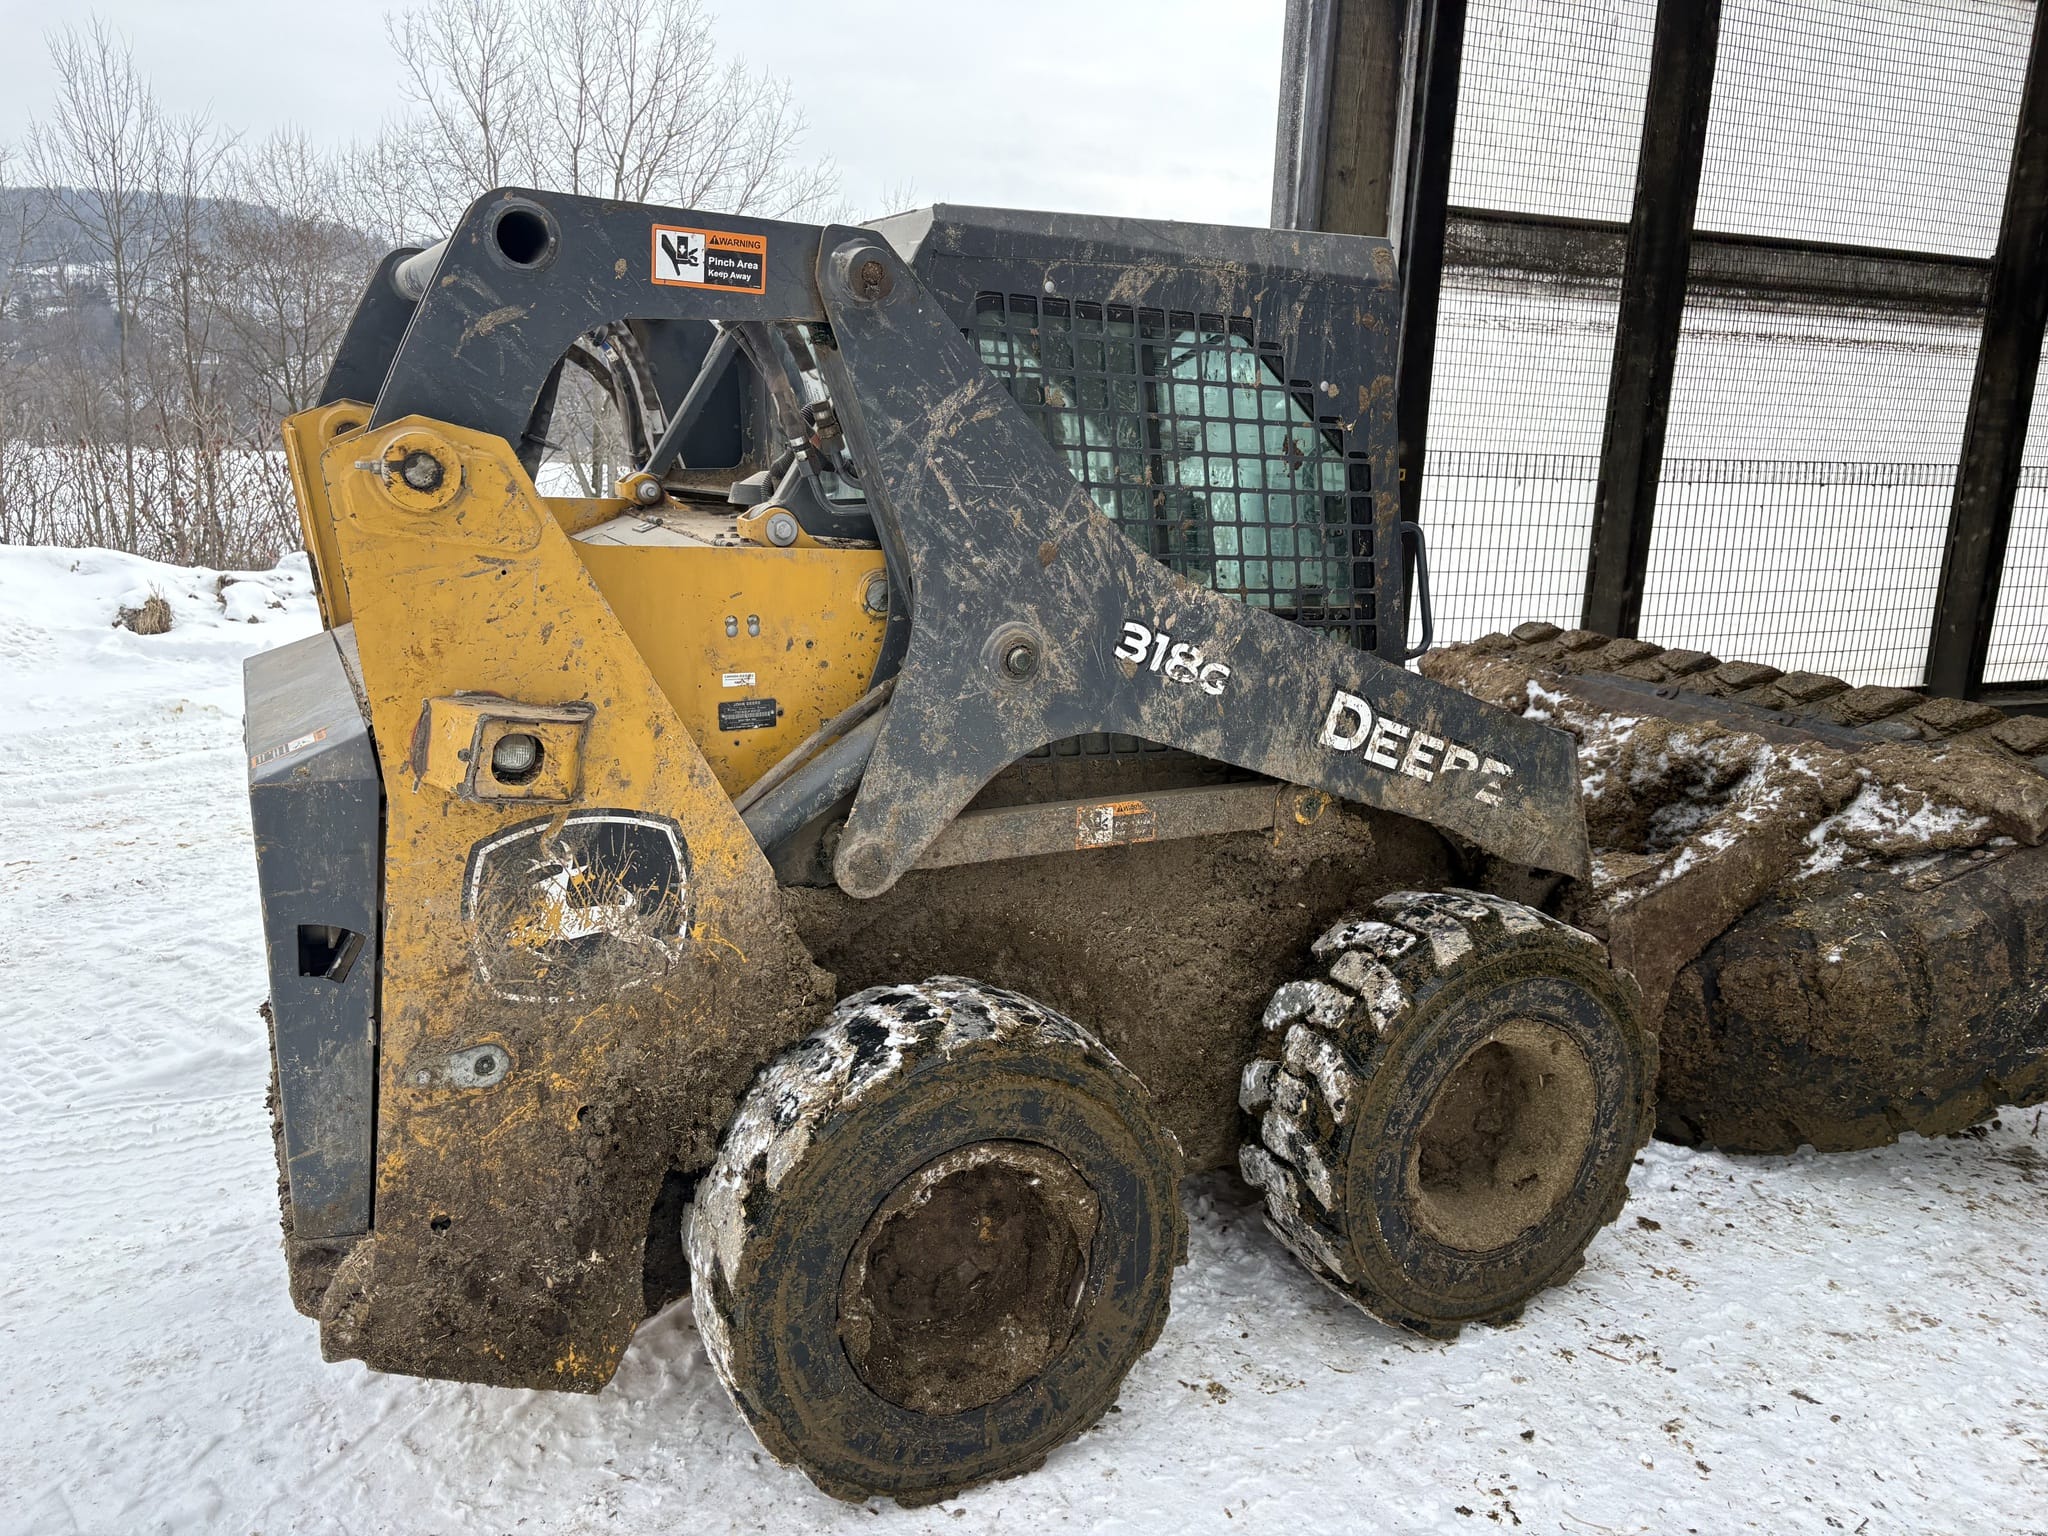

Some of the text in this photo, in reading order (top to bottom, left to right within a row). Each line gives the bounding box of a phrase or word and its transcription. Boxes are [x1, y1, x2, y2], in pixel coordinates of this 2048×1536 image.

[719, 237, 761, 249] WARNING
[708, 256, 759, 270] Pinch Area
[708, 269, 752, 282] Keep Away
[1114, 621, 1231, 695] 318G
